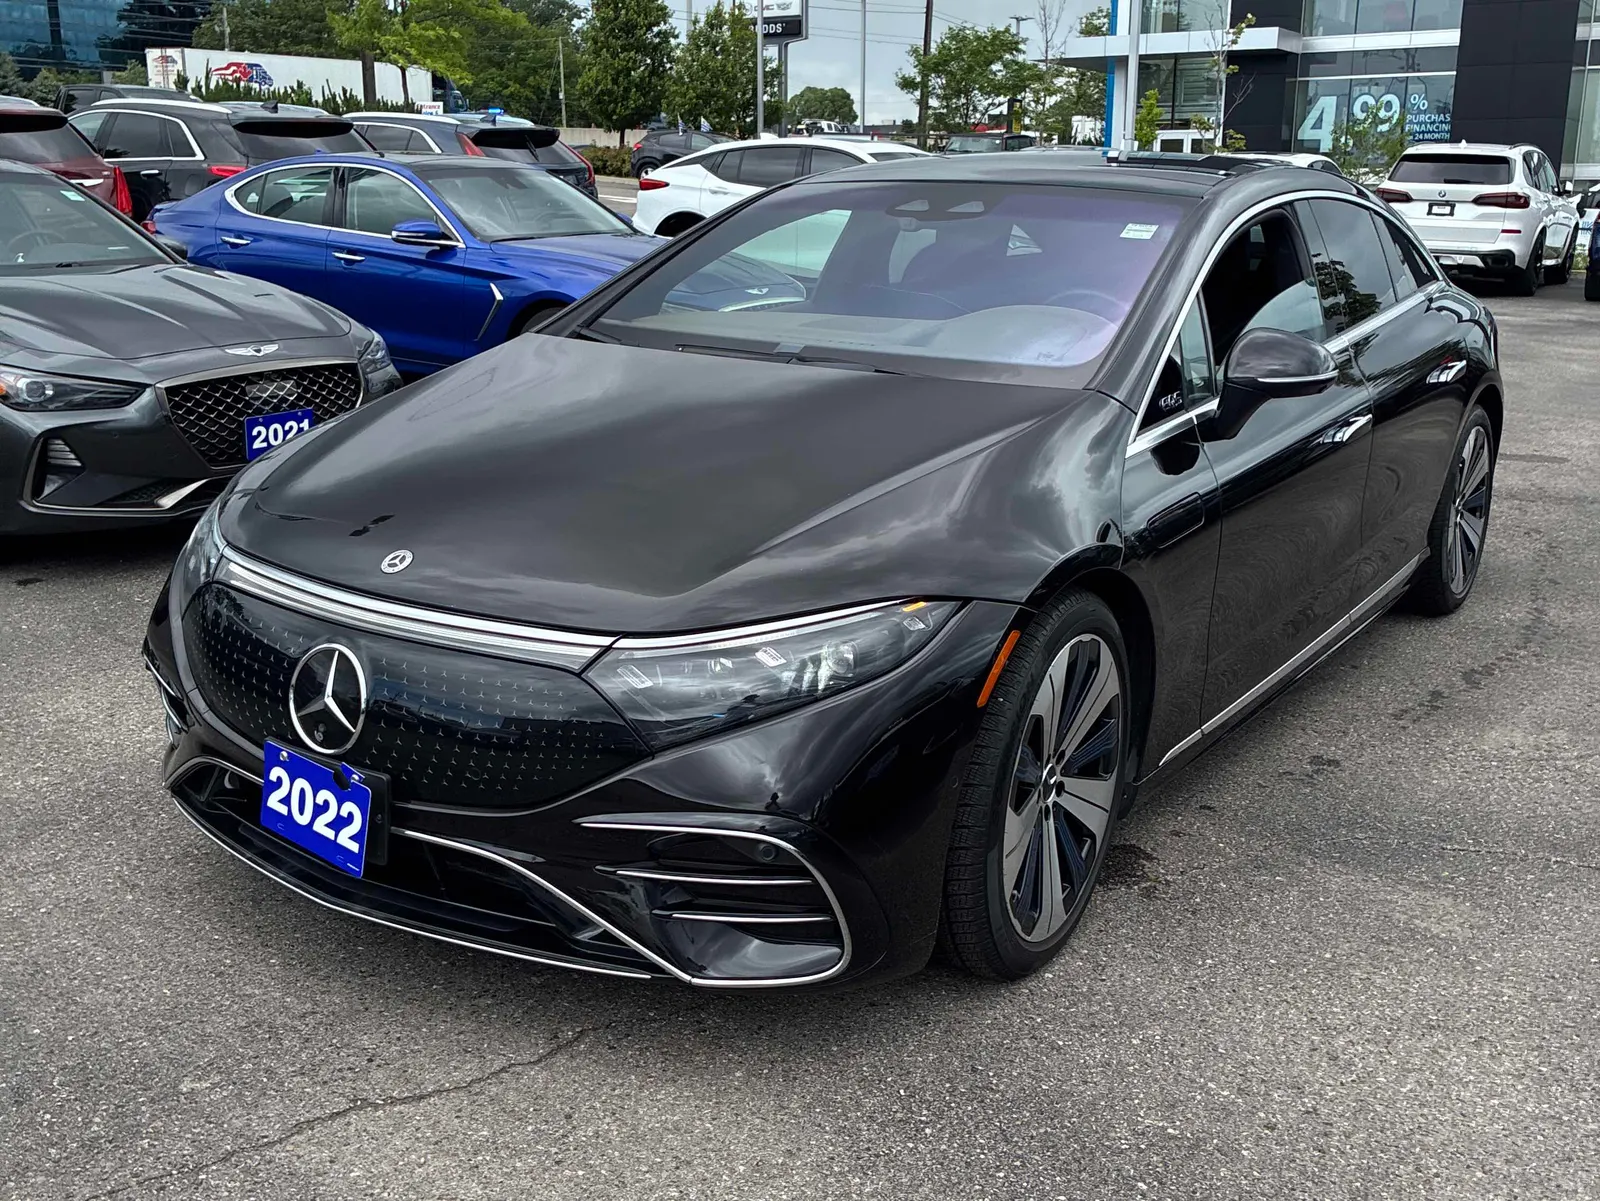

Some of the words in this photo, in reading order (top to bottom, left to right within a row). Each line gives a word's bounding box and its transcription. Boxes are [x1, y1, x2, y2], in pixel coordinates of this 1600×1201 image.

[749, 23, 786, 34] DDS'
[1410, 93, 1428, 110] %
[1405, 124, 1451, 132] FINANCIN
[251, 418, 310, 449] 2021
[266, 766, 363, 854] 2022
